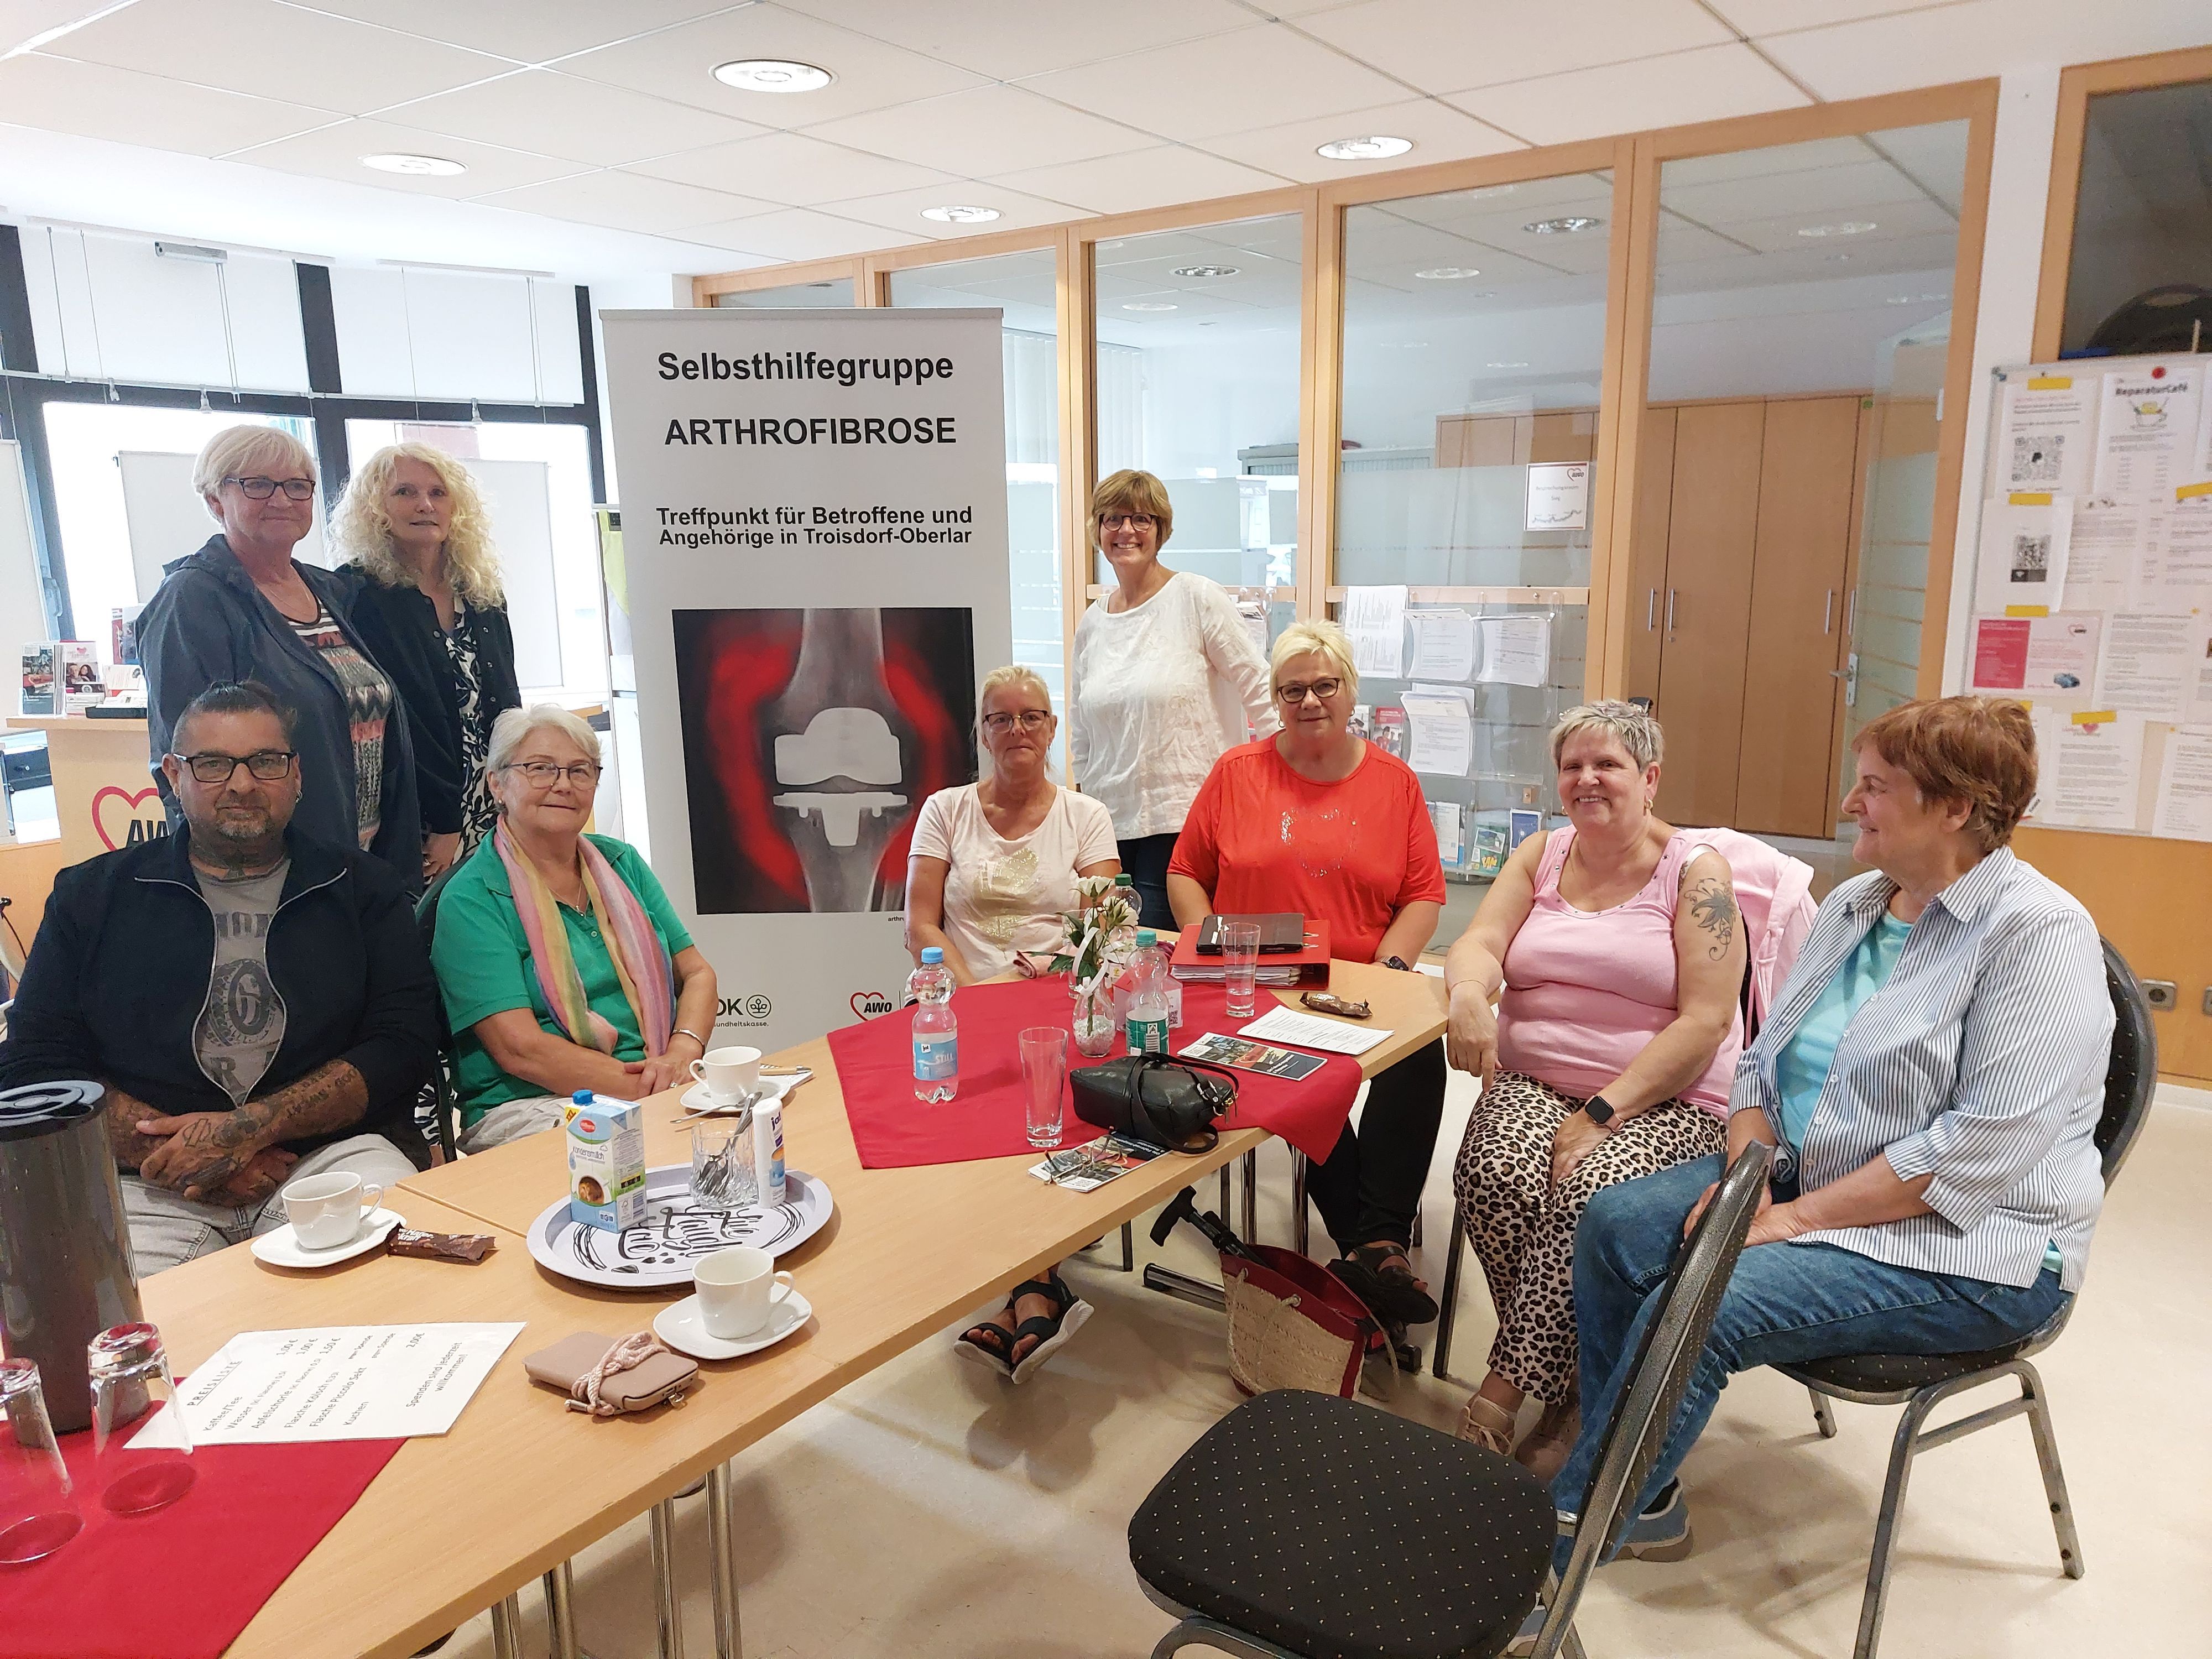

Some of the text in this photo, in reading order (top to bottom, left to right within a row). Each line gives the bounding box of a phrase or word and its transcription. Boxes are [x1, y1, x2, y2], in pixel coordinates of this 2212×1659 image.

[658, 352, 954, 387] Selbsthilfegruppe
[665, 417, 956, 445] ARTHROFIBROSE
[656, 505, 972, 529] Treffpunkt für Betroffene und
[659, 527, 972, 549] Angehörige in Troisdorf-Oberlar
[864, 1002, 893, 1013] AWO
[771, 1112, 781, 1131] ja!
[186, 1361, 240, 1406] PREISLISTE
[225, 1406, 253, 1430] Wasser
[296, 1343, 314, 1355] 1,00
[251, 1390, 293, 1429] Apfelschorle
[319, 1342, 336, 1354] 1,50
[405, 1342, 462, 1407] Spenden sind jederzeit
[434, 1354, 468, 1392] willkommen!
[203, 1396, 243, 1431] Kaffee/Tee
[283, 1404, 311, 1428] Flasche
[305, 1384, 329, 1404] Kölsch
[309, 1404, 336, 1427] Flasche
[330, 1381, 354, 1402] Piccolo
[348, 1367, 367, 1380] Sekt
[342, 1401, 369, 1426] Kuchen
